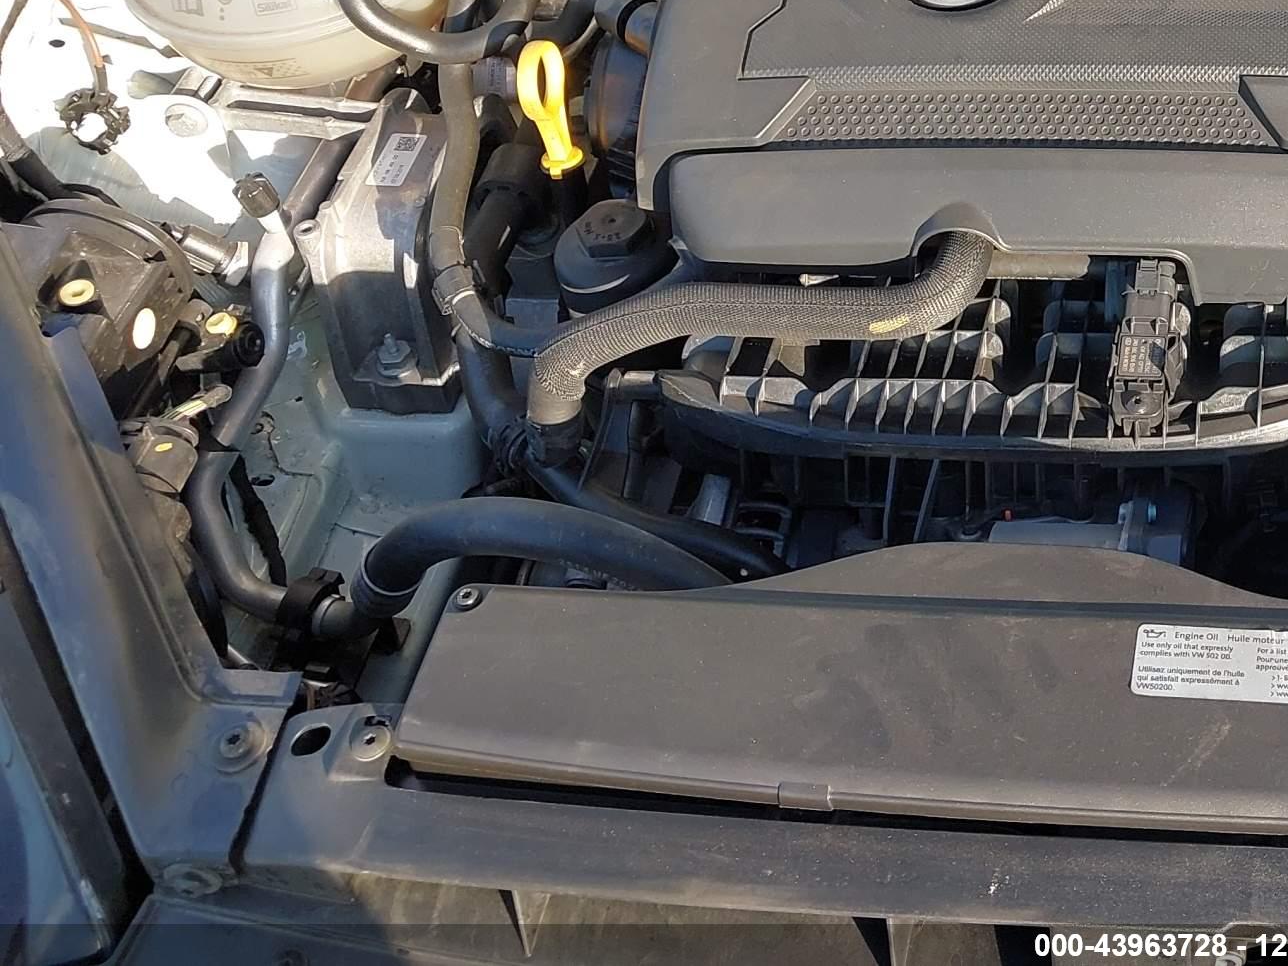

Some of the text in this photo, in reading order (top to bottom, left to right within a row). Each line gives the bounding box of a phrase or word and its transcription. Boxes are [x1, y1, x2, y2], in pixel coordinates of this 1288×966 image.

[1175, 632, 1204, 641] Engine
[1227, 635, 1284, 645] Huile moteur
[1156, 642, 1172, 650] only
[1201, 644, 1233, 652] expressly
[1141, 650, 1172, 658] complies
[1167, 667, 1210, 675] uniquement
[1137, 674, 1148, 682] qui
[1181, 677, 1233, 686] expressément
